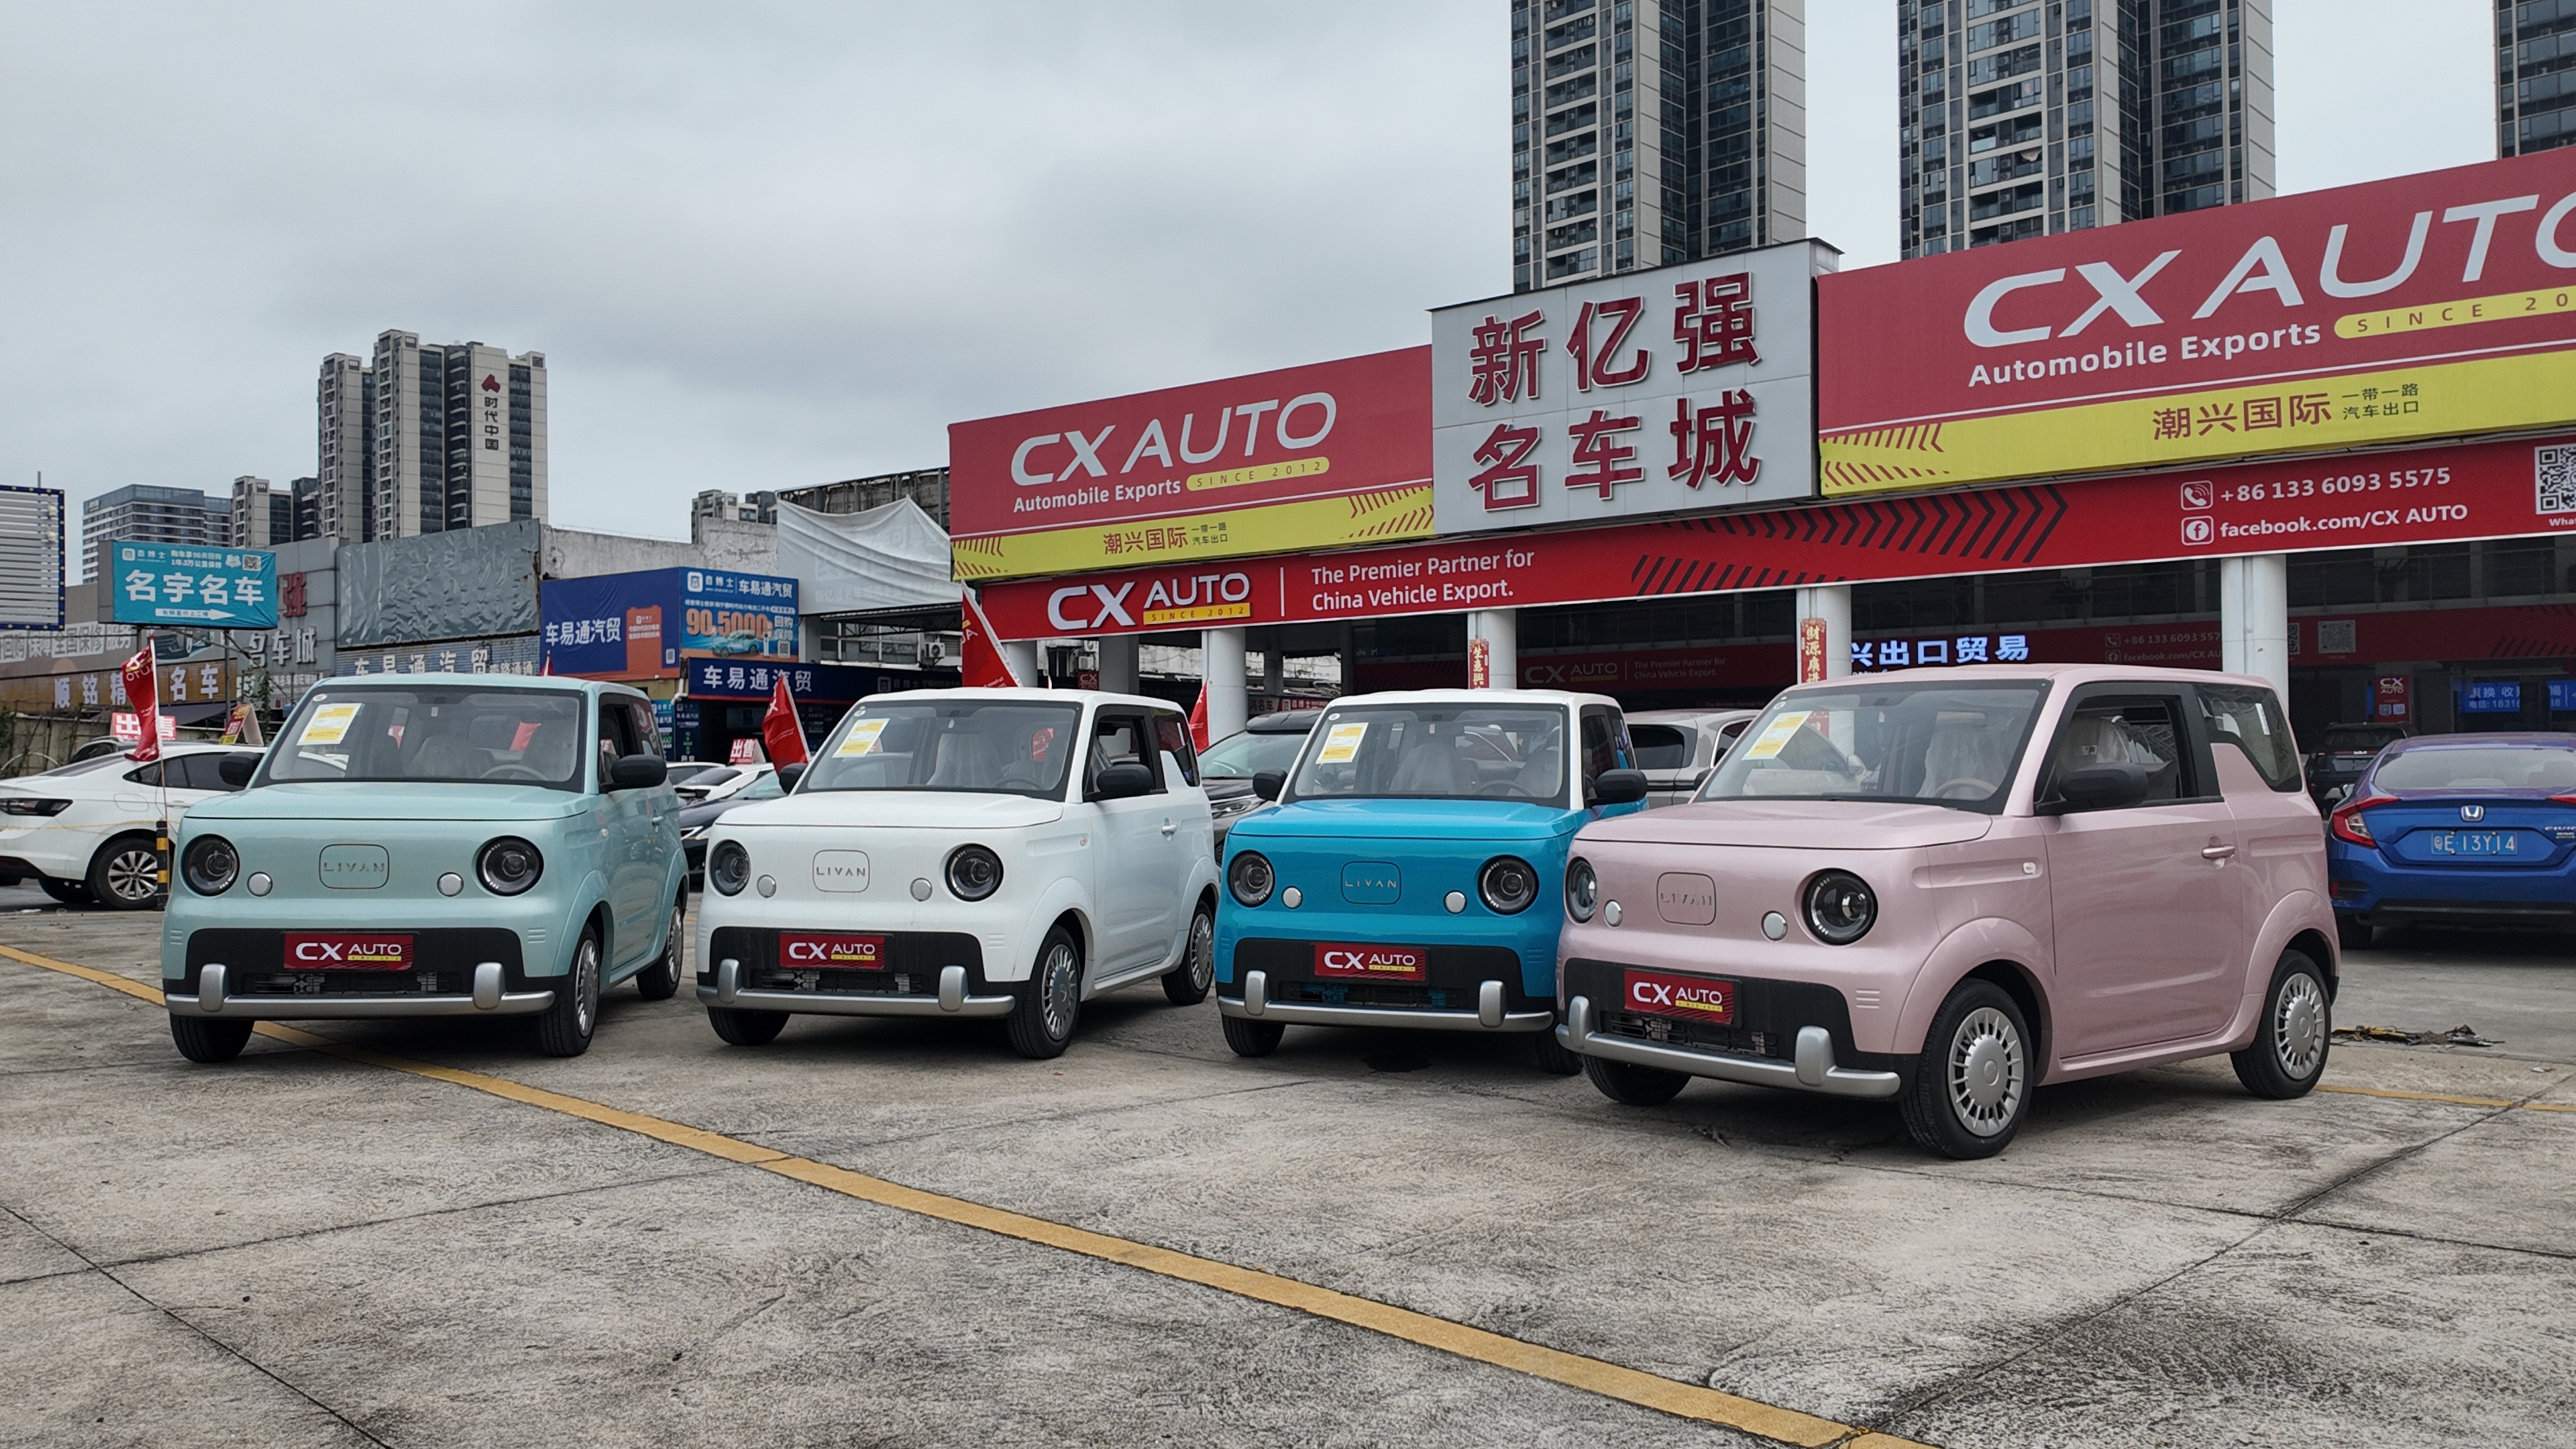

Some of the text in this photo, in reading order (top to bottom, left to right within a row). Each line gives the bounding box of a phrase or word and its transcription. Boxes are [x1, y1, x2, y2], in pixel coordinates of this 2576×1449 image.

[1964, 249, 2183, 348] CX
[1467, 272, 1760, 406] 新亿强
[1968, 341, 2167, 387] Automobile
[2181, 323, 2321, 360] Exports
[2357, 304, 2483, 333] SINCE
[2342, 383, 2419, 401] 一带一路
[2153, 392, 2332, 440] 潮兴国际
[2343, 400, 2419, 420] 汽车出口
[484, 397, 498, 450] 时代中国
[1011, 392, 1337, 486] CX AUTO
[1468, 388, 1762, 513] 名车城
[1013, 461, 1322, 513] Automobile Exports SINCE 2012
[2221, 467, 2450, 502] +86 133 6093 5575
[1191, 522, 1226, 533] 一带一路
[2220, 504, 2467, 538] facebook.com/CX AUTO
[1103, 525, 1188, 555] 潮兴国际
[1193, 534, 1228, 545] 汽车出口
[1311, 548, 1534, 585] The Premier Partner for
[125, 570, 264, 606] 名宇名车
[739, 580, 793, 598] 车易通汽贸
[1311, 579, 1513, 612] China Vehicle Export.
[1047, 572, 1250, 631] CX AUTO
[1150, 606, 1244, 622] SINCE 2012
[545, 617, 621, 646] 车易通汽贸
[2148, 635, 2167, 644] 133
[2170, 633, 2197, 643] 6093
[1851, 635, 2029, 667] 兴出口贸易
[704, 665, 812, 692] 车易通汽贸
[1080, 674, 1097, 682] CX
[1525, 665, 1566, 684] CX
[1570, 662, 1617, 675] AUTO
[1634, 661, 1649, 669] The
[1650, 659, 1680, 669] Premier
[1683, 658, 1711, 667] Partner
[1714, 657, 1725, 665] for
[1634, 670, 1656, 679] China
[1658, 669, 1686, 678] Vehicle
[2380, 678, 2403, 687] CX
[731, 739, 755, 757] 出售
[324, 862, 384, 872] LIVAN
[816, 867, 866, 877] LIVAN
[1345, 879, 1397, 889] LIVAN
[1660, 892, 1712, 906] LIVAN
[296, 943, 402, 960] CX AUTO
[789, 943, 875, 959] CX AUTO
[1324, 951, 1364, 969] CX
[1369, 953, 1415, 965] AUTO
[1633, 981, 1722, 1006] CX AUTO
